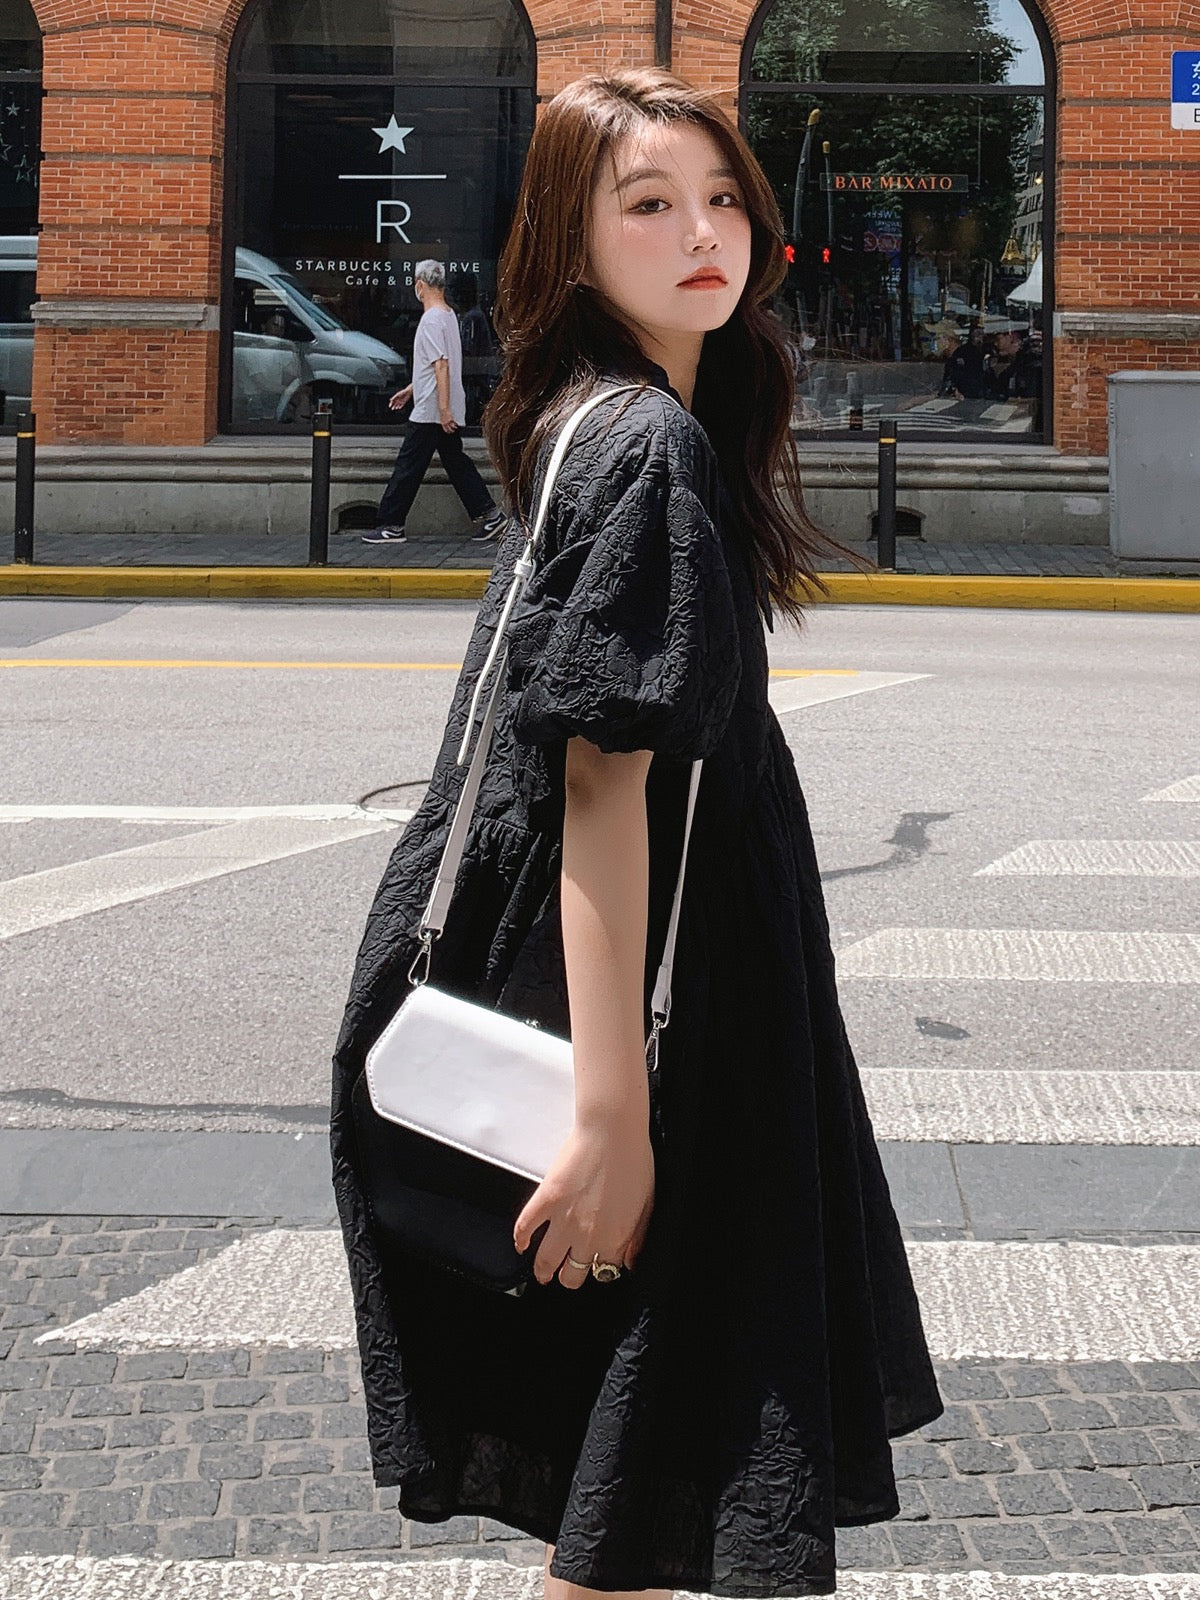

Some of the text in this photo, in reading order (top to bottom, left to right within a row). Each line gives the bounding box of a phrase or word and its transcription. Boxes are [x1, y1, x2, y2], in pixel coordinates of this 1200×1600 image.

[834, 175, 953, 190] BAR MIXATO
[376, 200, 411, 244] R
[295, 260, 480, 273] STARBUCKS RRVE
[345, 275, 380, 286] Cafe
[387, 275, 396, 286] &
